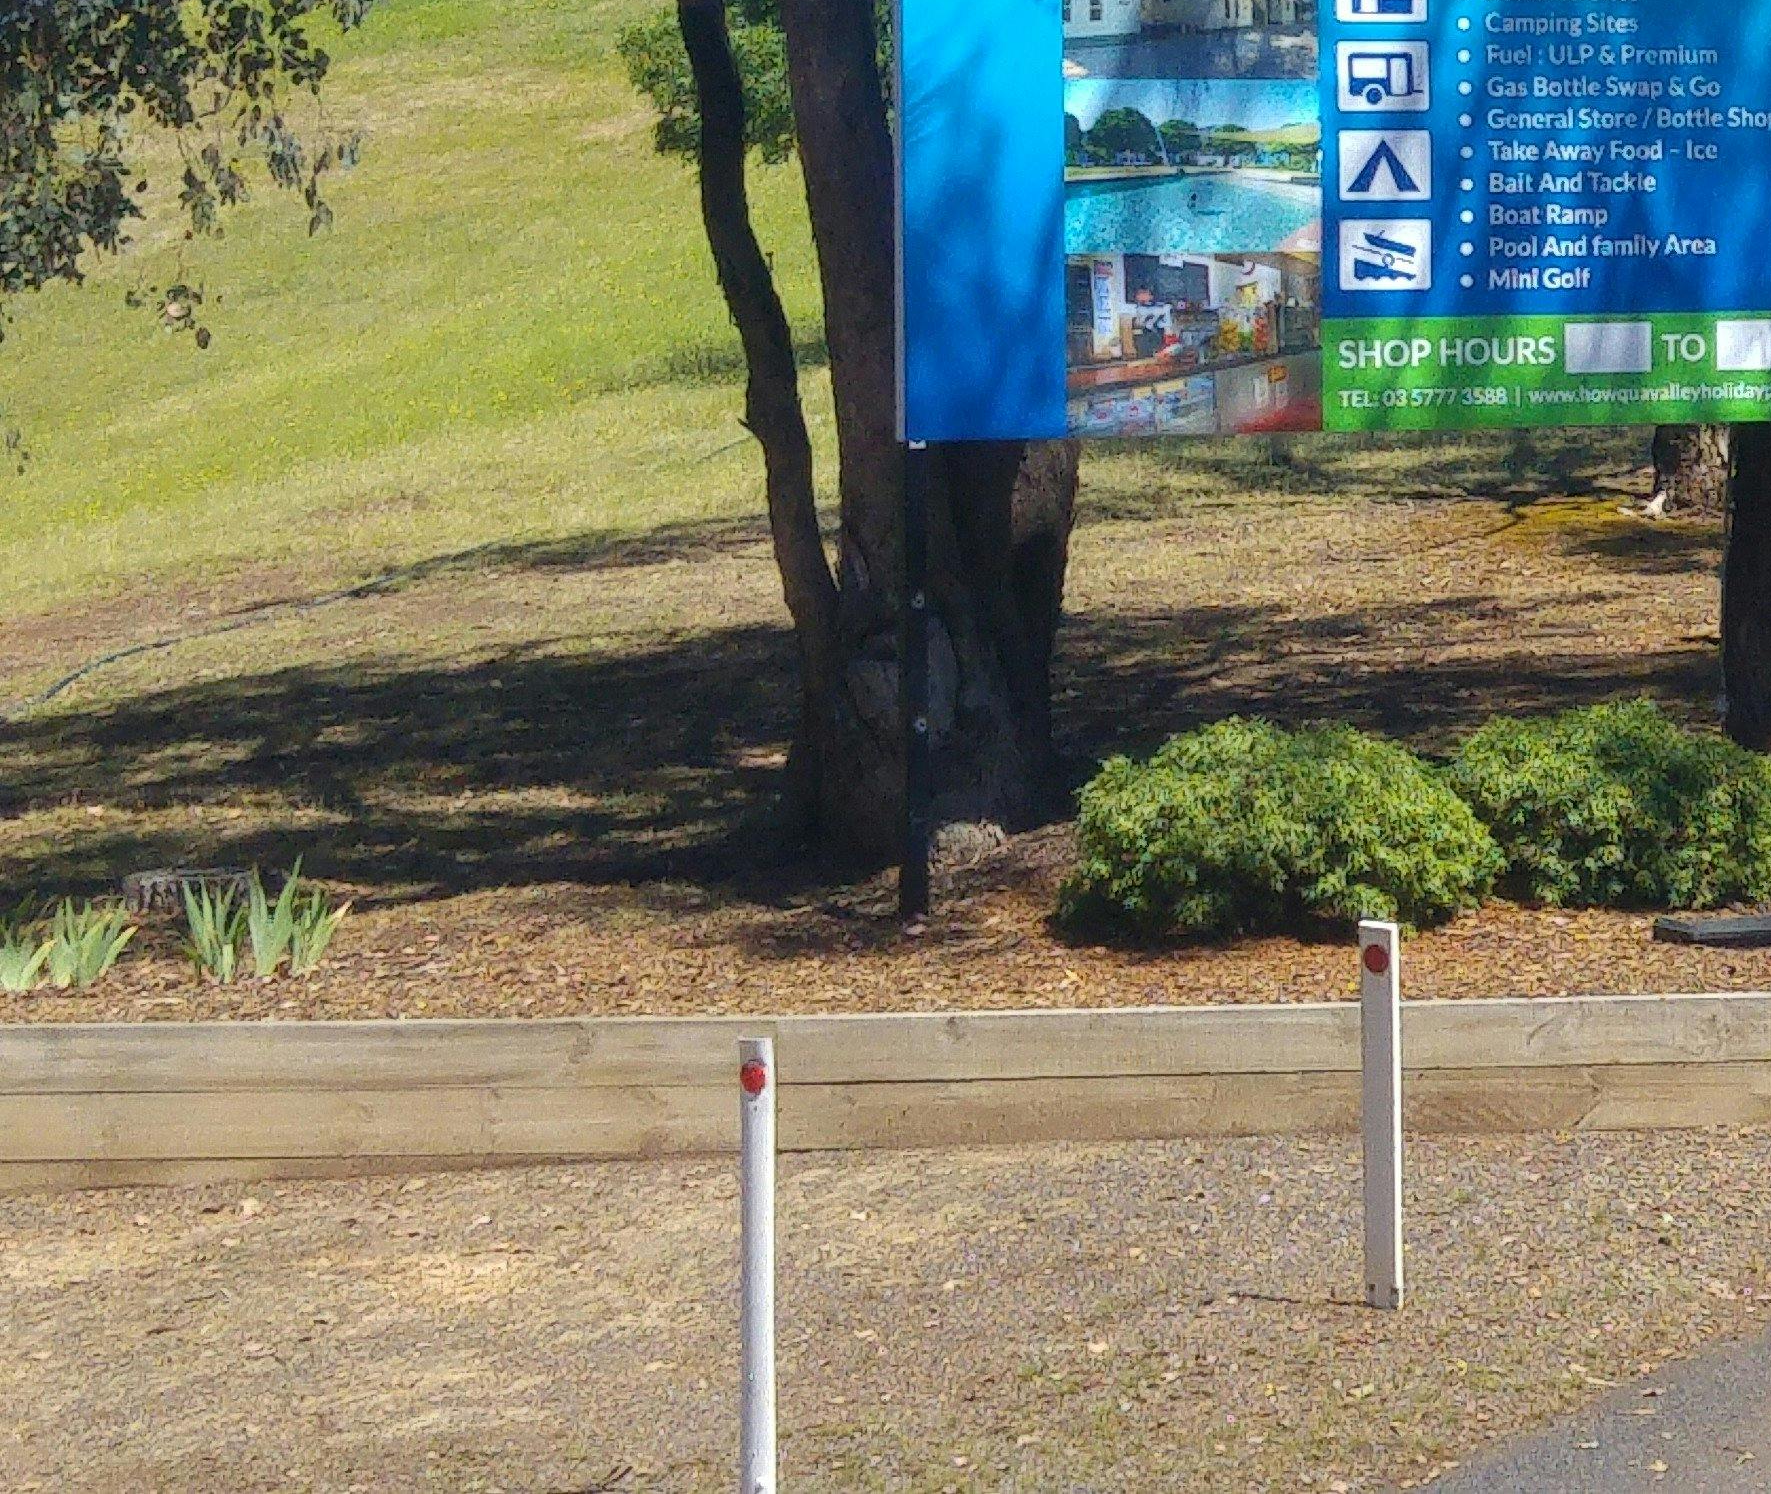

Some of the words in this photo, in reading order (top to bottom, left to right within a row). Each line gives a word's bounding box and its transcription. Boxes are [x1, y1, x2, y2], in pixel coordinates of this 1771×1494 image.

[1485, 12, 1581, 37] Camping
[1586, 12, 1639, 34] Sites
[1486, 44, 1531, 65] Fuel
[1549, 44, 1594, 65] ULP
[1600, 44, 1616, 66] &
[1621, 44, 1718, 66] Premium
[1487, 76, 1527, 97] Gas
[1533, 76, 1600, 97] Bottle
[1605, 77, 1662, 100] Swap
[1668, 76, 1685, 97] &
[1689, 76, 1721, 97] Go
[1487, 107, 1573, 129] General
[1578, 107, 1638, 129] Store
[1642, 107, 1650, 129] /
[1656, 107, 1723, 129] Bottle
[1487, 140, 1539, 161] Take
[1543, 140, 1605, 164] Away
[1610, 139, 1663, 161] Food
[1686, 140, 1718, 160] Ice
[1489, 172, 1533, 193] Bait
[1539, 172, 1583, 193] And
[1587, 172, 1657, 193] Tackle
[1489, 204, 1541, 225] Boat
[1546, 204, 1608, 229] Ramp
[1489, 236, 1538, 257] Pool
[1541, 236, 1586, 257] And
[1592, 234, 1659, 259] family
[1664, 234, 1716, 255] Area
[1489, 268, 1539, 290] Mini
[1542, 267, 1591, 289] Golf
[1338, 338, 1431, 369] SHOP
[1439, 336, 1556, 367] HOURS
[1660, 333, 1706, 363] TO
[1382, 389, 1408, 407] 03
[1411, 387, 1457, 407] 5777
[1462, 387, 1509, 406] 3588
